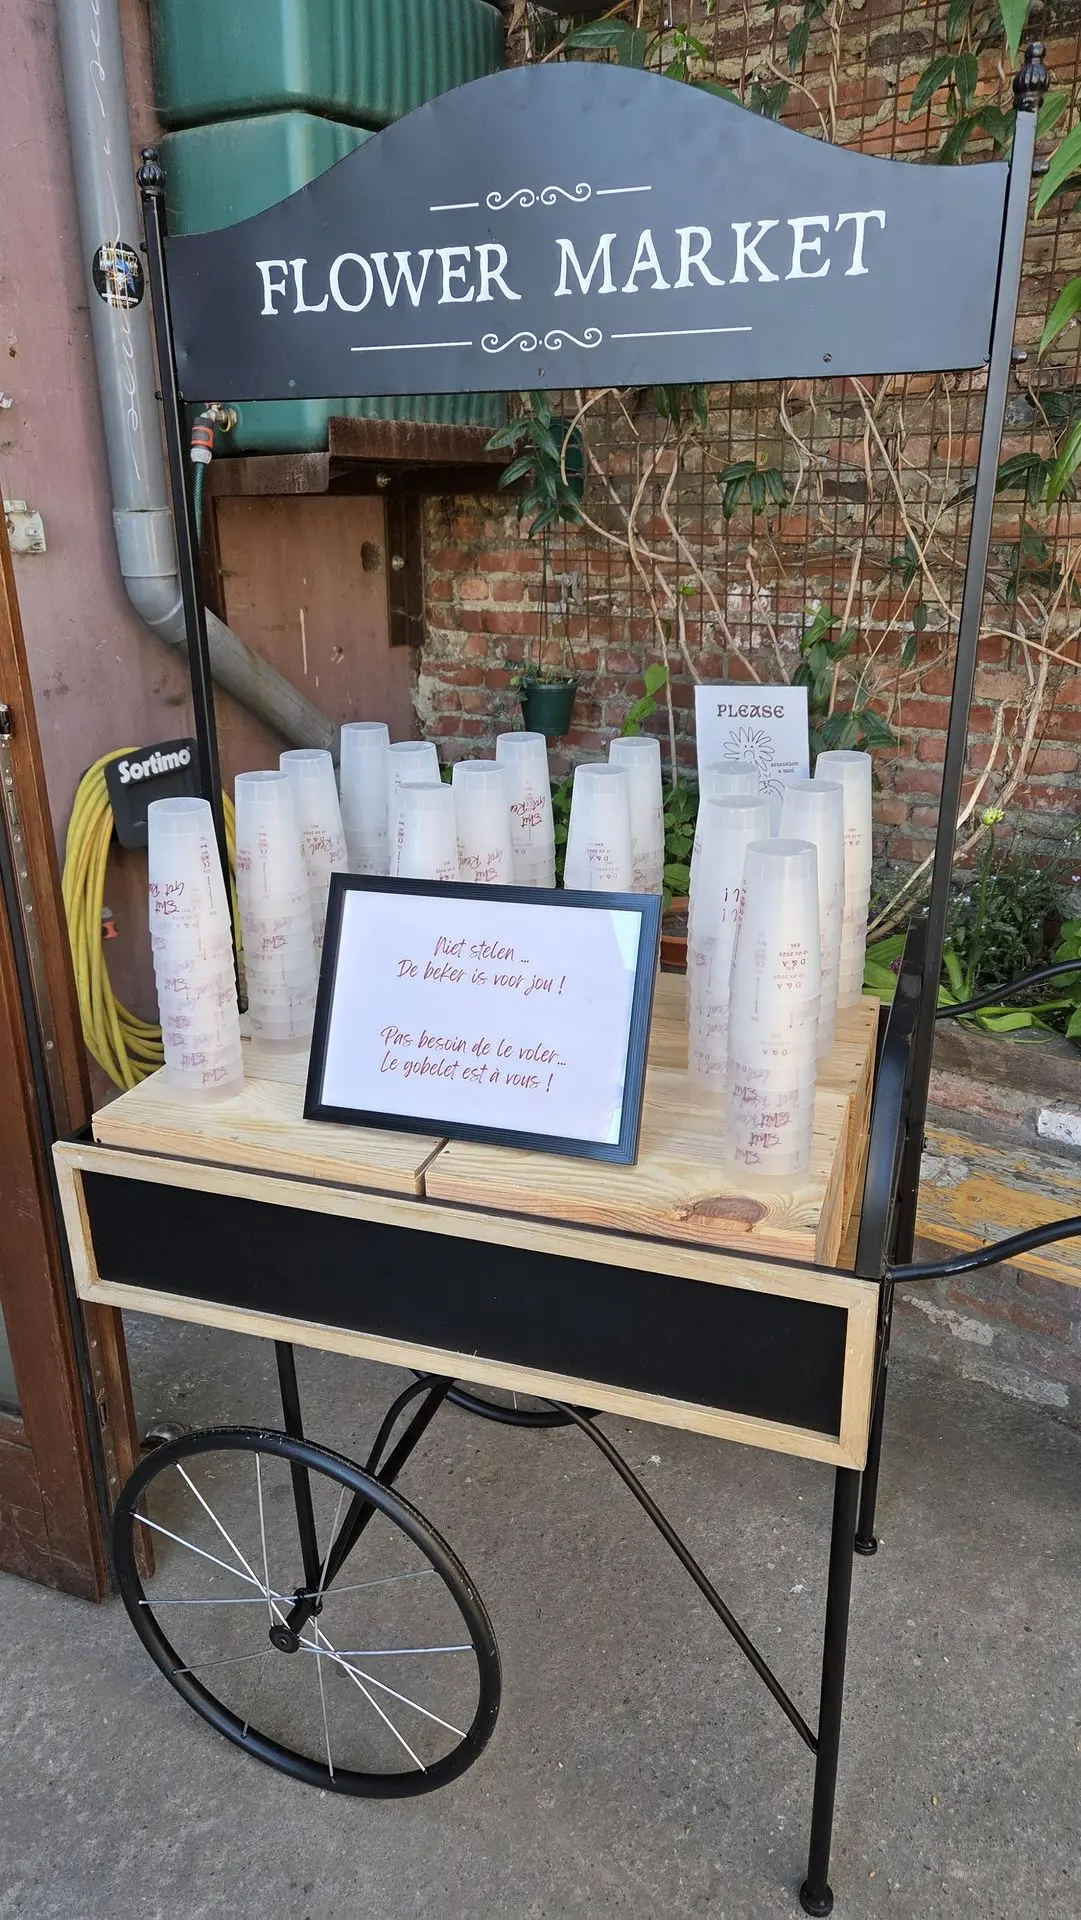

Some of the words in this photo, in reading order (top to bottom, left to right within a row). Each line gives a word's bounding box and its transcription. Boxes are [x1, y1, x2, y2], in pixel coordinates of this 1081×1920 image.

[256, 243, 522, 316] FLOWER
[554, 209, 887, 297] MARKET
[717, 704, 785, 719] PLEASE
[118, 747, 191, 784] Sortimo
[770, 759, 799, 768] attention
[434, 936, 467, 959] Niet
[469, 940, 515, 962] stelen
[397, 959, 418, 978] De
[424, 961, 467, 983] beker
[471, 968, 488, 986] is
[494, 973, 524, 990] voor
[524, 974, 554, 996] jou
[558, 975, 567, 995] !
[380, 1026, 414, 1047] Pas
[418, 1030, 467, 1053] besoin
[472, 1037, 493, 1058] de
[497, 1038, 513, 1059] le
[380, 1048, 399, 1073] Le
[404, 1056, 461, 1080] gobelet
[462, 1063, 489, 1084] est
[489, 1067, 501, 1084] à
[506, 1072, 541, 1089] vous
[546, 1073, 554, 1092] !
